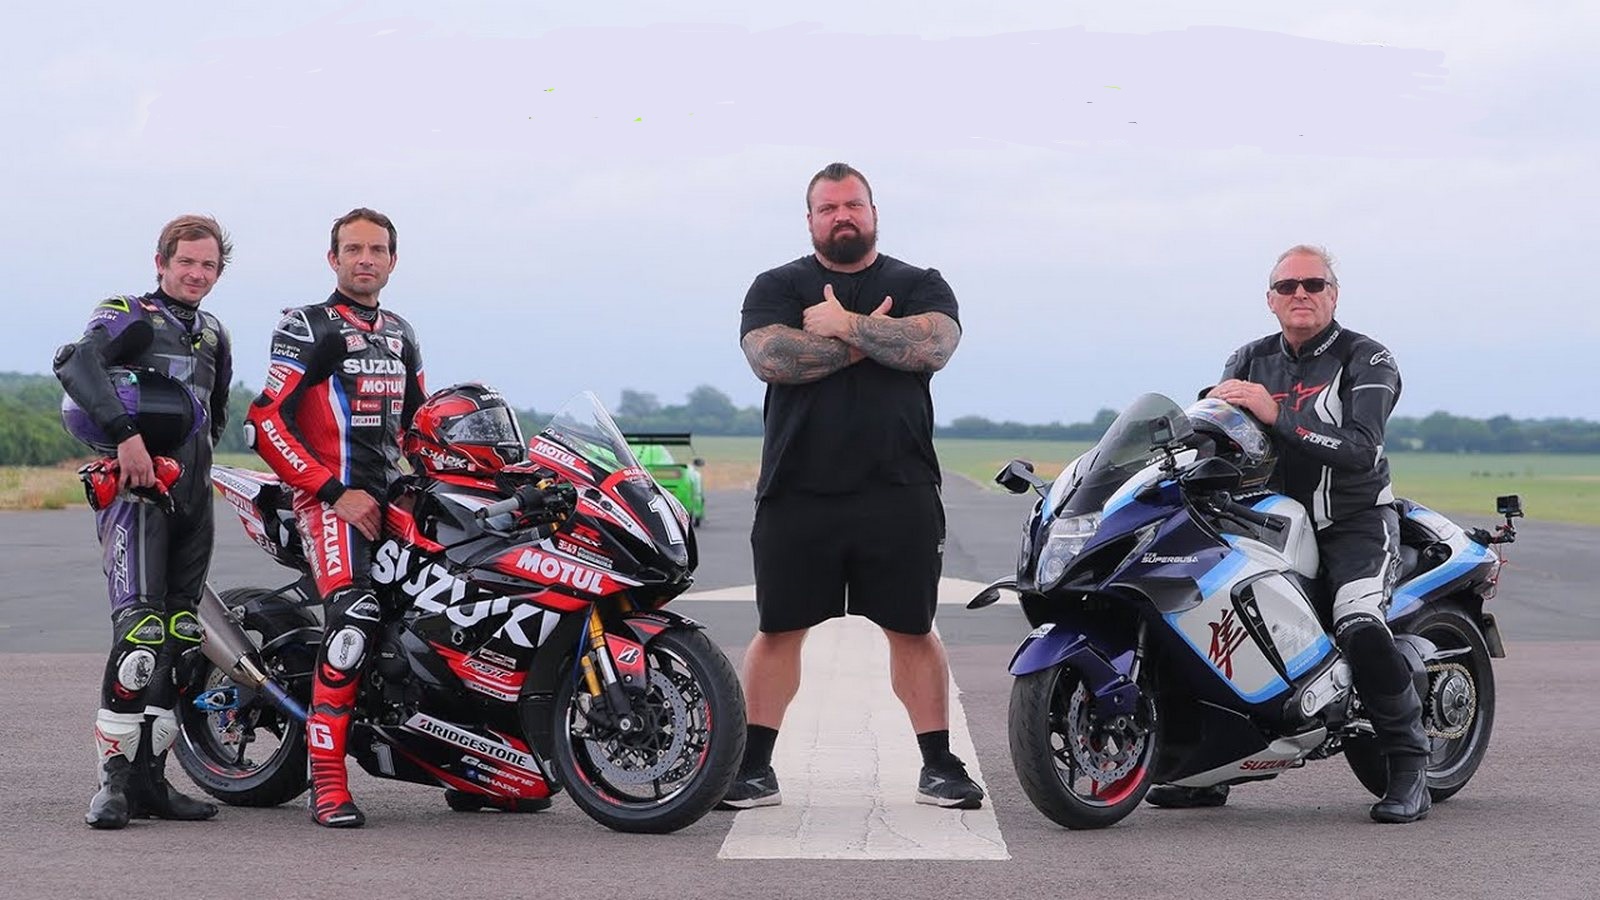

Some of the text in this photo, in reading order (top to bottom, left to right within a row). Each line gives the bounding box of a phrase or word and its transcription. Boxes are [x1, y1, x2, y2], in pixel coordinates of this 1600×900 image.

[343, 359, 406, 375] SUZUK
[361, 380, 403, 393] MOTUL
[261, 419, 307, 473] SUZUKI
[420, 446, 467, 469] SHARK
[534, 441, 577, 466] MOTUL
[647, 494, 684, 545] 1
[515, 549, 604, 595] MOTUL
[1140, 556, 1199, 564] SUPERBUSA
[371, 539, 562, 649] SUZUKI
[462, 658, 514, 681] RST
[418, 718, 529, 767] BRIDGESTONE
[477, 774, 521, 796] SHARK
